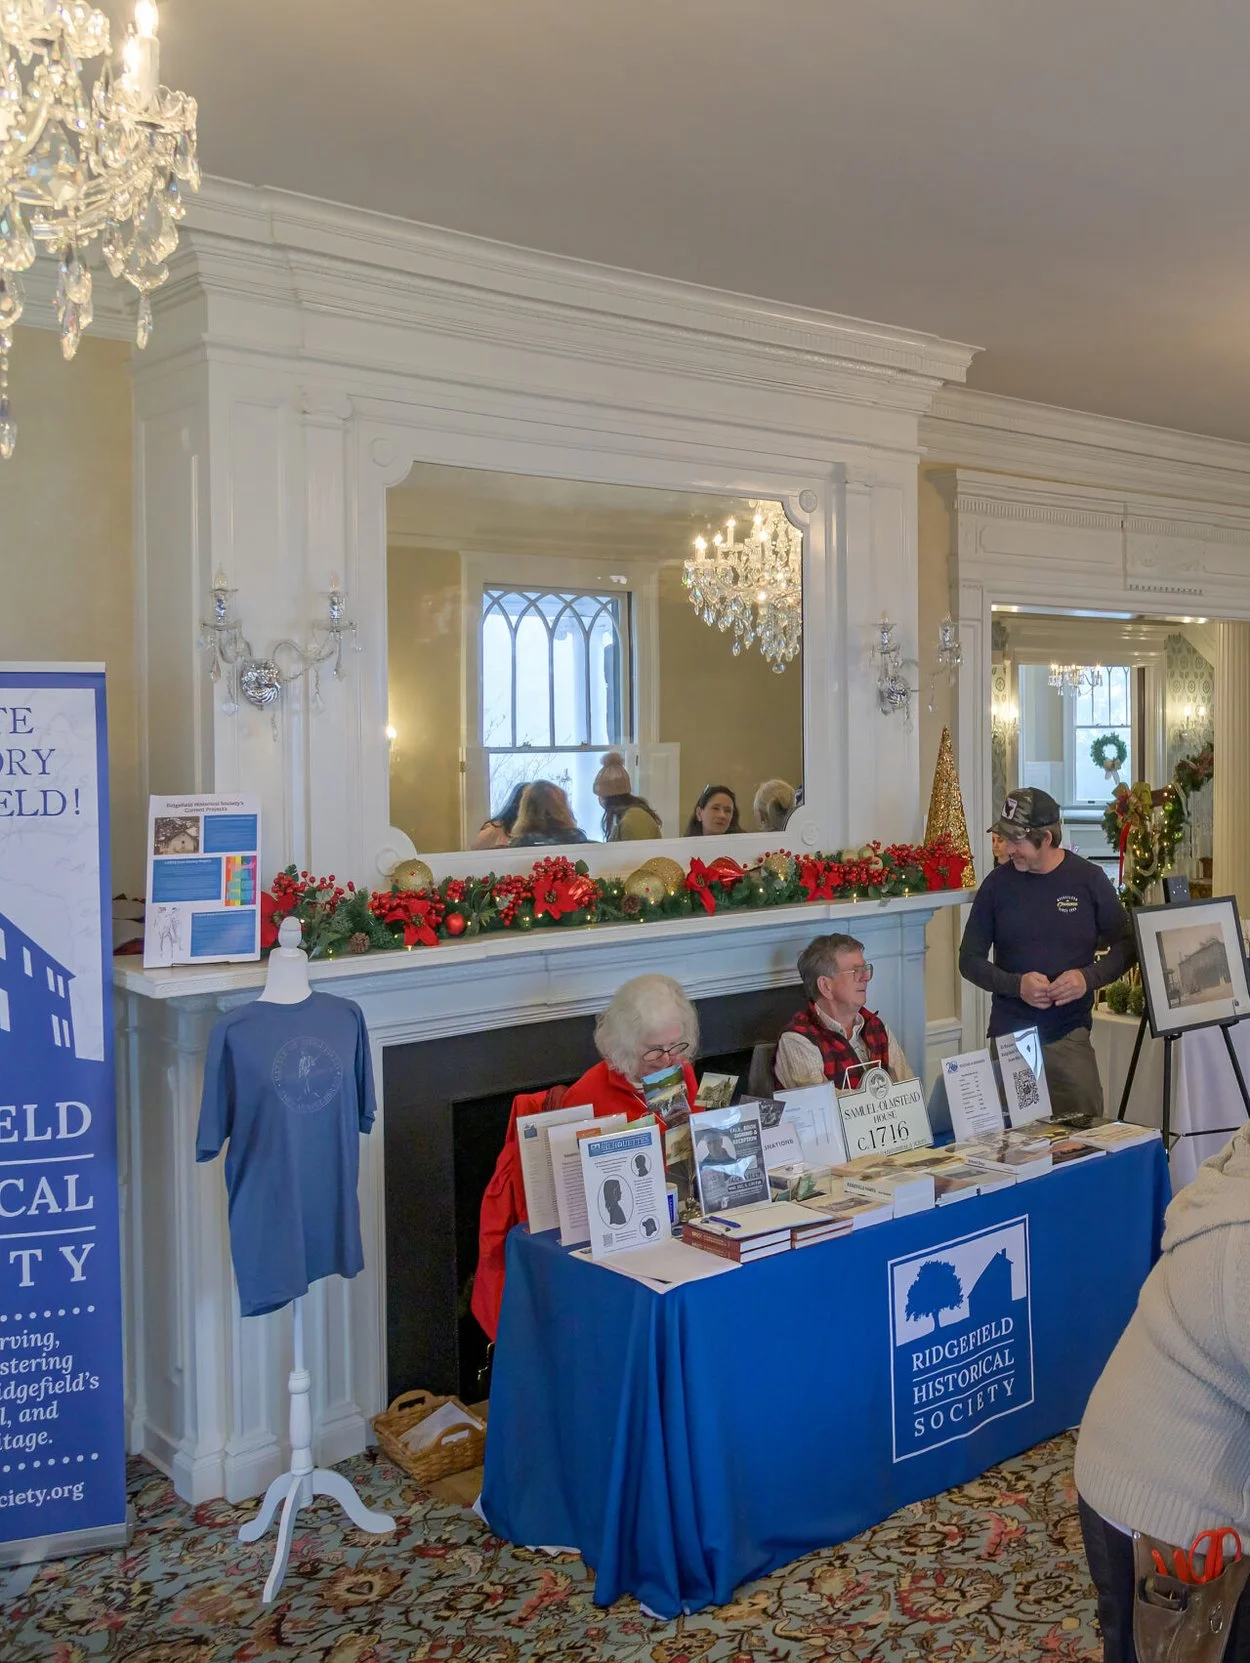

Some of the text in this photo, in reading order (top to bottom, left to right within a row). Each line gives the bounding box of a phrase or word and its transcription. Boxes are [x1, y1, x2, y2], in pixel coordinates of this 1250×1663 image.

[0, 707, 34, 734] E
[0, 748, 56, 775] RY
[844, 1090, 921, 1120] SAMUEL OLMSTEAD
[873, 1111, 897, 1124] HOUSE
[0, 1101, 92, 1143] ELD
[0, 1174, 94, 1218] CAL
[911, 1316, 1015, 1373] RIDGEFIELD
[0, 1353, 73, 1376] stering
[913, 1348, 1016, 1406] HISTORICAL
[18, 1400, 60, 1424] and
[914, 1377, 1016, 1438] SOCIETY
